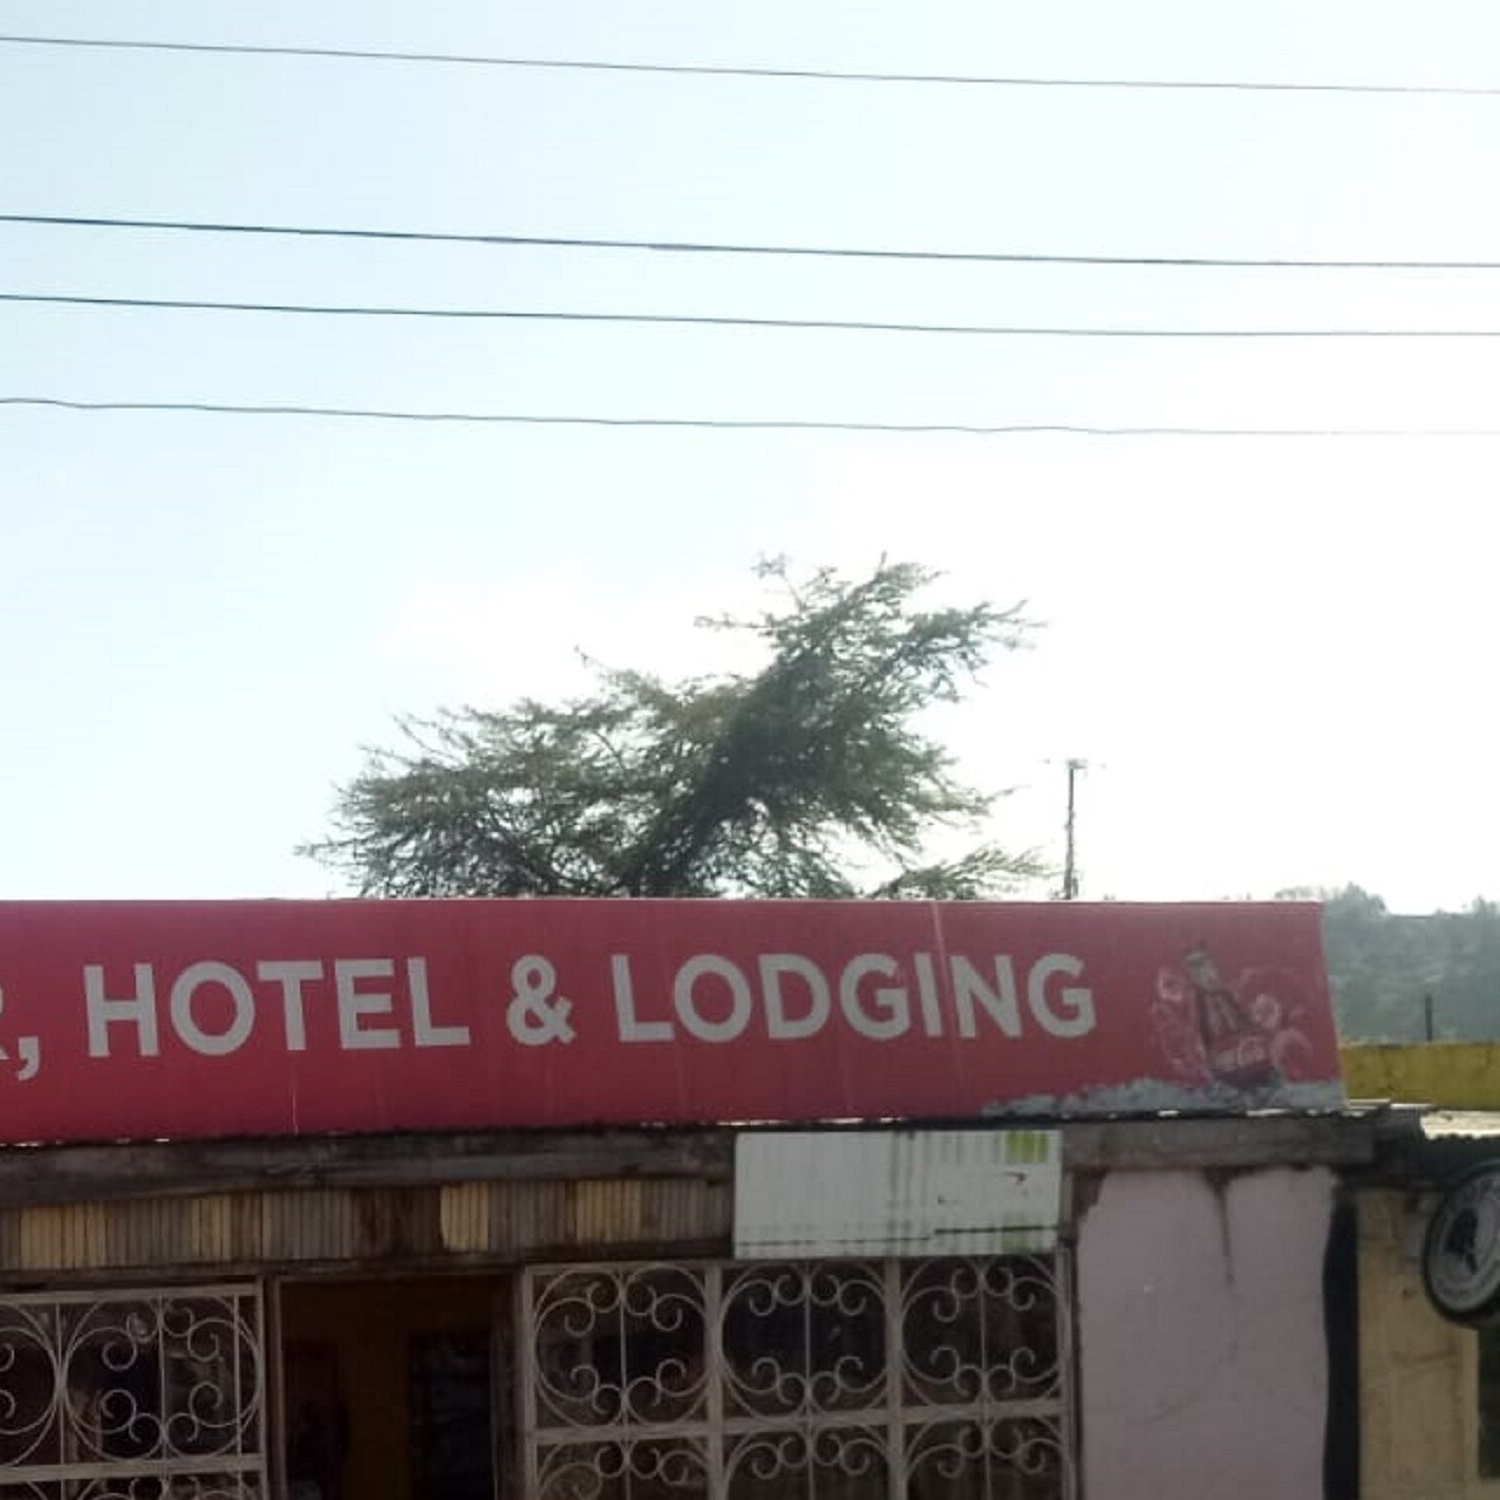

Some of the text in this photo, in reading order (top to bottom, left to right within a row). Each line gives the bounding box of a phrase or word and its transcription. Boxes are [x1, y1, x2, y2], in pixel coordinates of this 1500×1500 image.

[83, 957, 471, 1058] HOTEL
[506, 954, 576, 1047] &
[610, 951, 1097, 1043] LODGING
